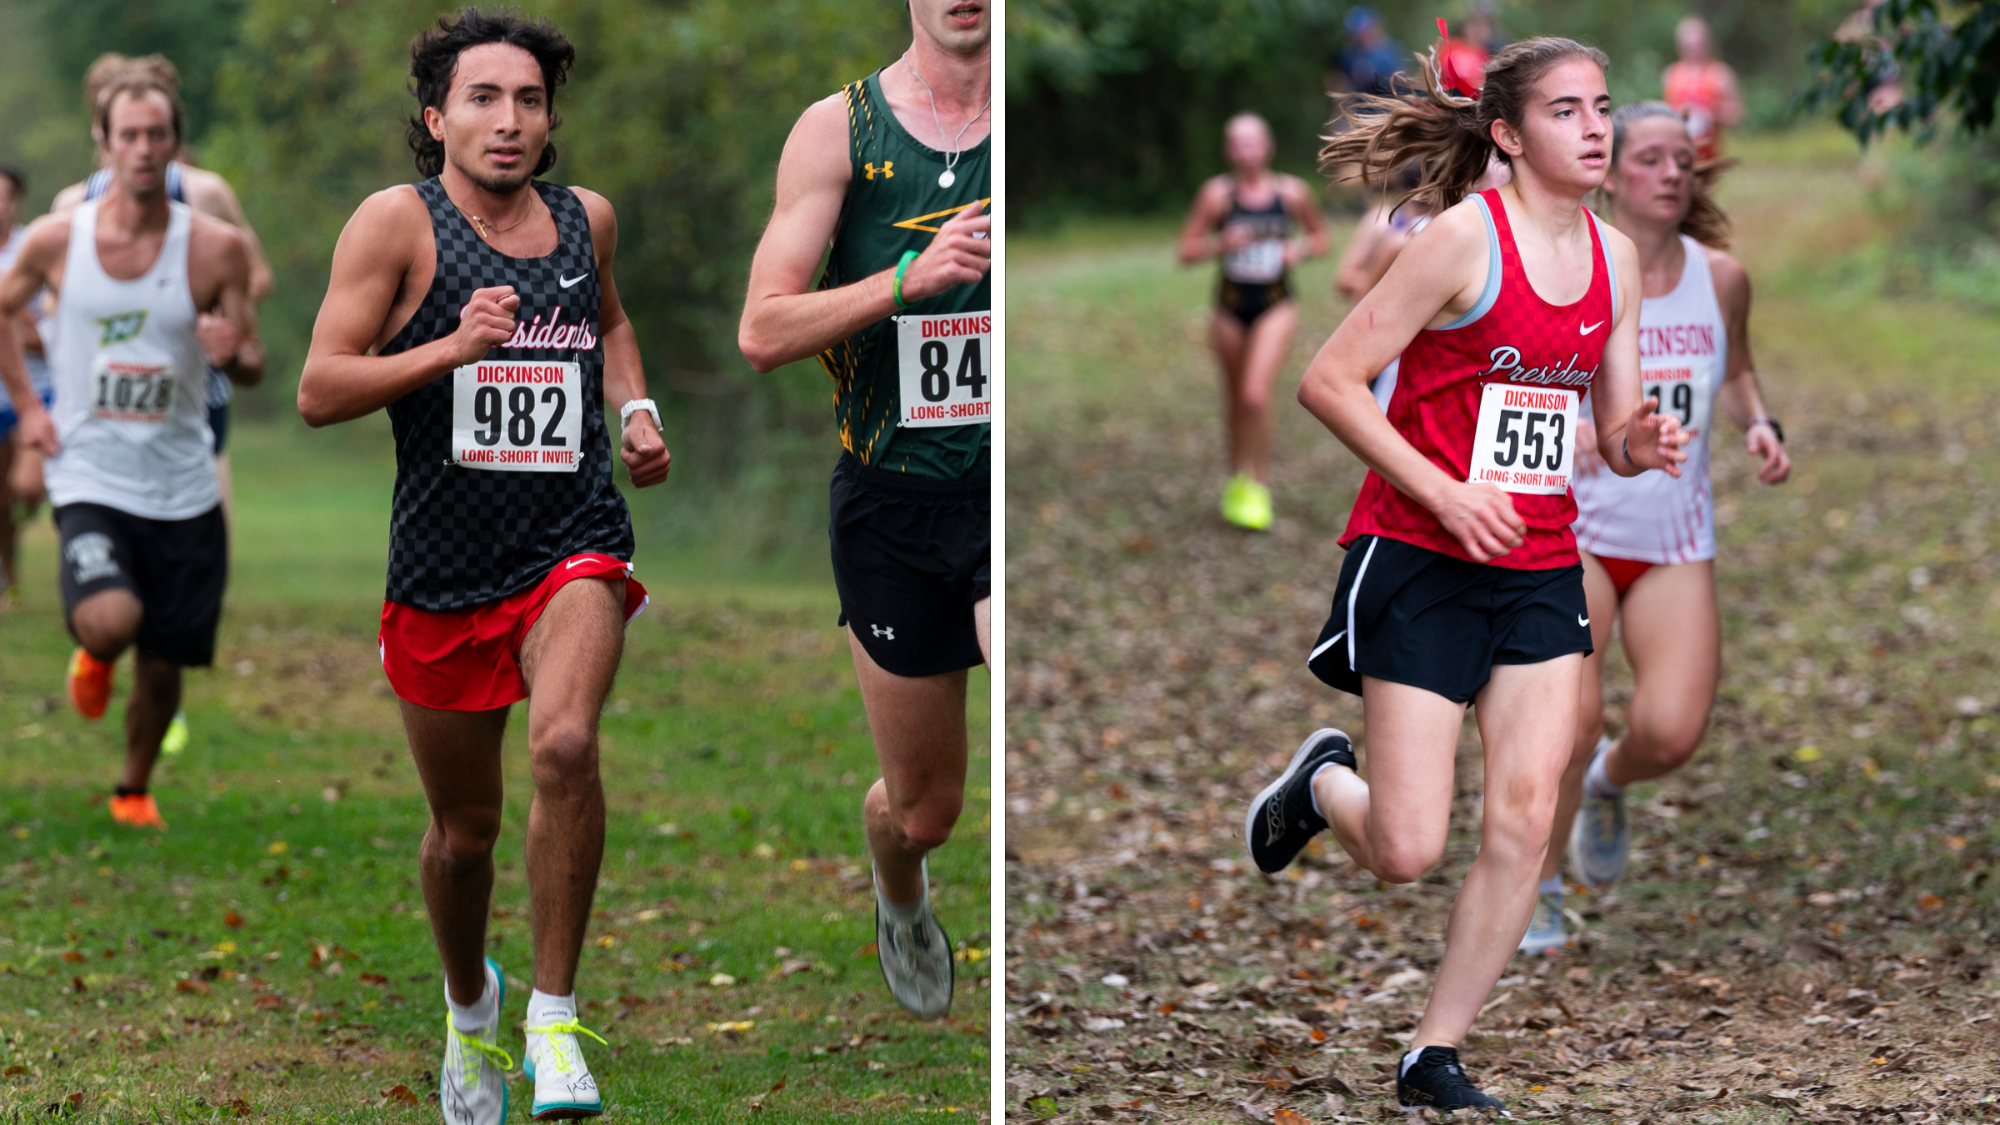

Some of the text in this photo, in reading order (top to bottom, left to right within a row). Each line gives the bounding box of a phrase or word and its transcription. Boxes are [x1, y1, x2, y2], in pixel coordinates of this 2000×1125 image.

[922, 315, 990, 338] DICKINS
[477, 366, 564, 384] DICKINSON
[920, 338, 987, 402] 84
[98, 375, 173, 411] 1028
[1504, 390, 1568, 411] DICKINSON
[474, 386, 567, 447] 982
[910, 401, 990, 420] LONG-SHORT
[1493, 409, 1565, 471] 553
[461, 449, 574, 464] LONG-SHORT INVITE
[1480, 468, 1567, 488] LONG-SHORT INVITE
